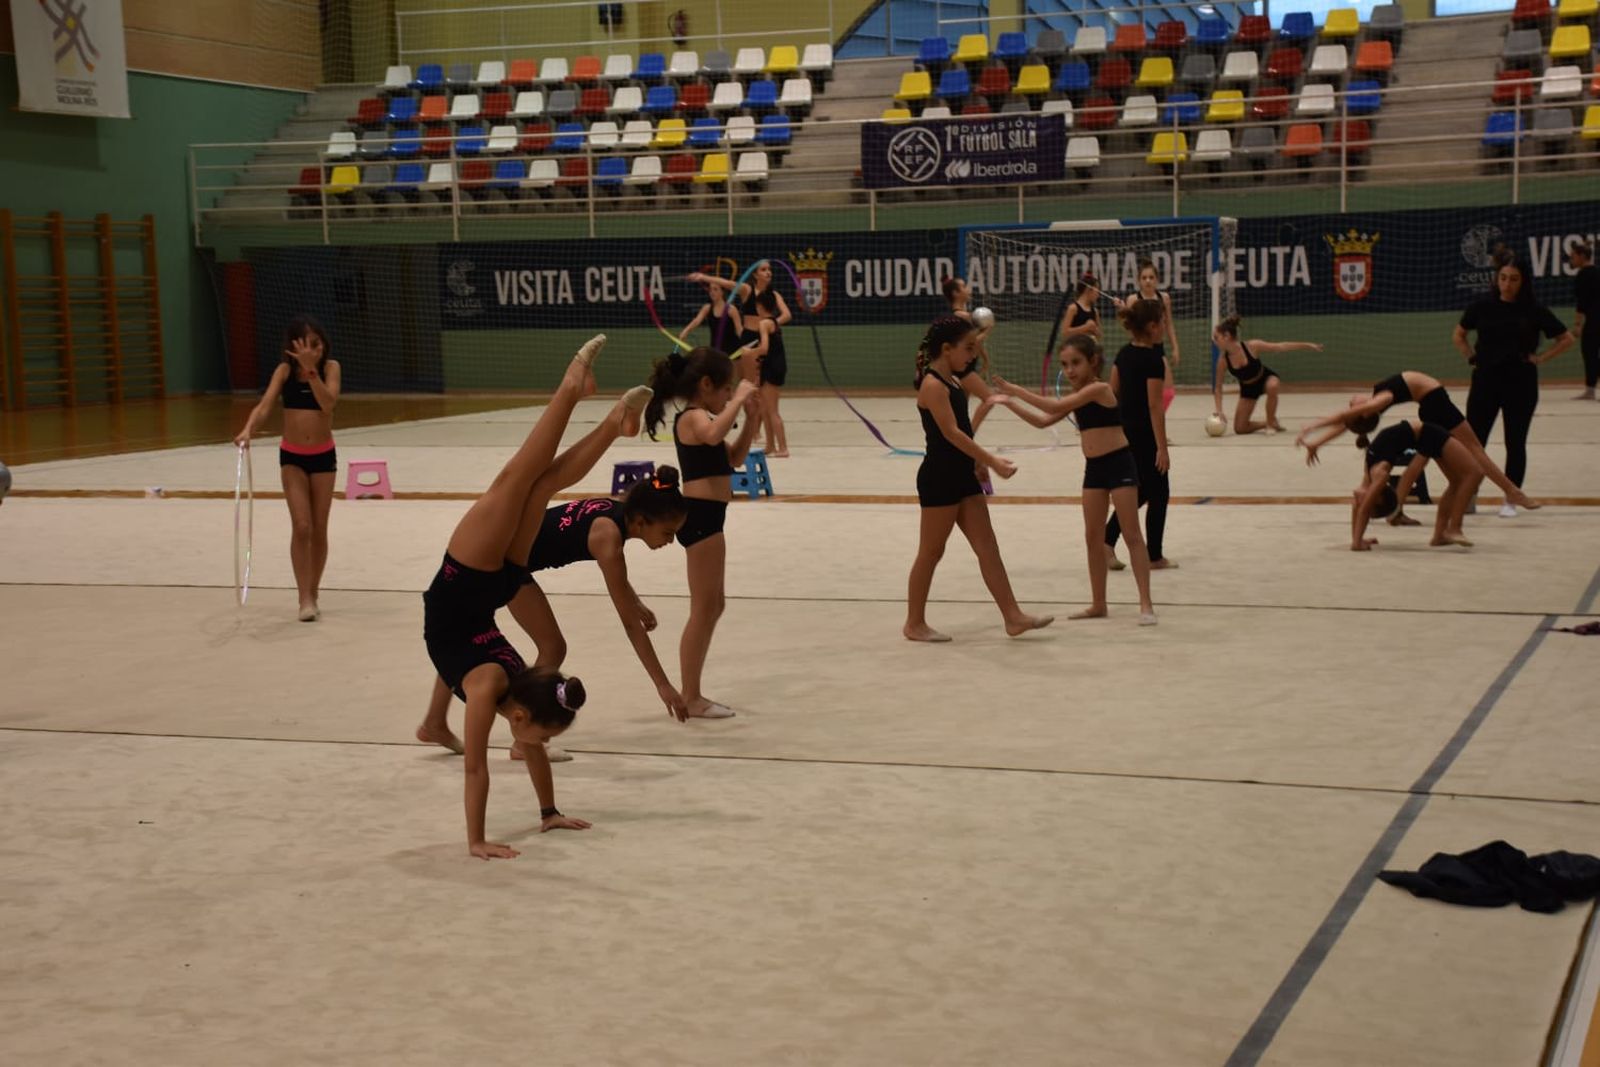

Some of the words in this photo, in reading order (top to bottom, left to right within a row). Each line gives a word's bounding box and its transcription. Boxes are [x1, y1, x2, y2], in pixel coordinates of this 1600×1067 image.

[961, 117, 1037, 134] DIVISIÓN
[1009, 129, 1037, 150] SALA
[974, 160, 1037, 177] Iberdrola
[845, 256, 954, 298] CIUDAD
[967, 244, 1141, 295] AUTÓNOMA
[1152, 249, 1191, 290] DE
[494, 269, 574, 306] VISITA
[585, 265, 666, 303] CEUTA
